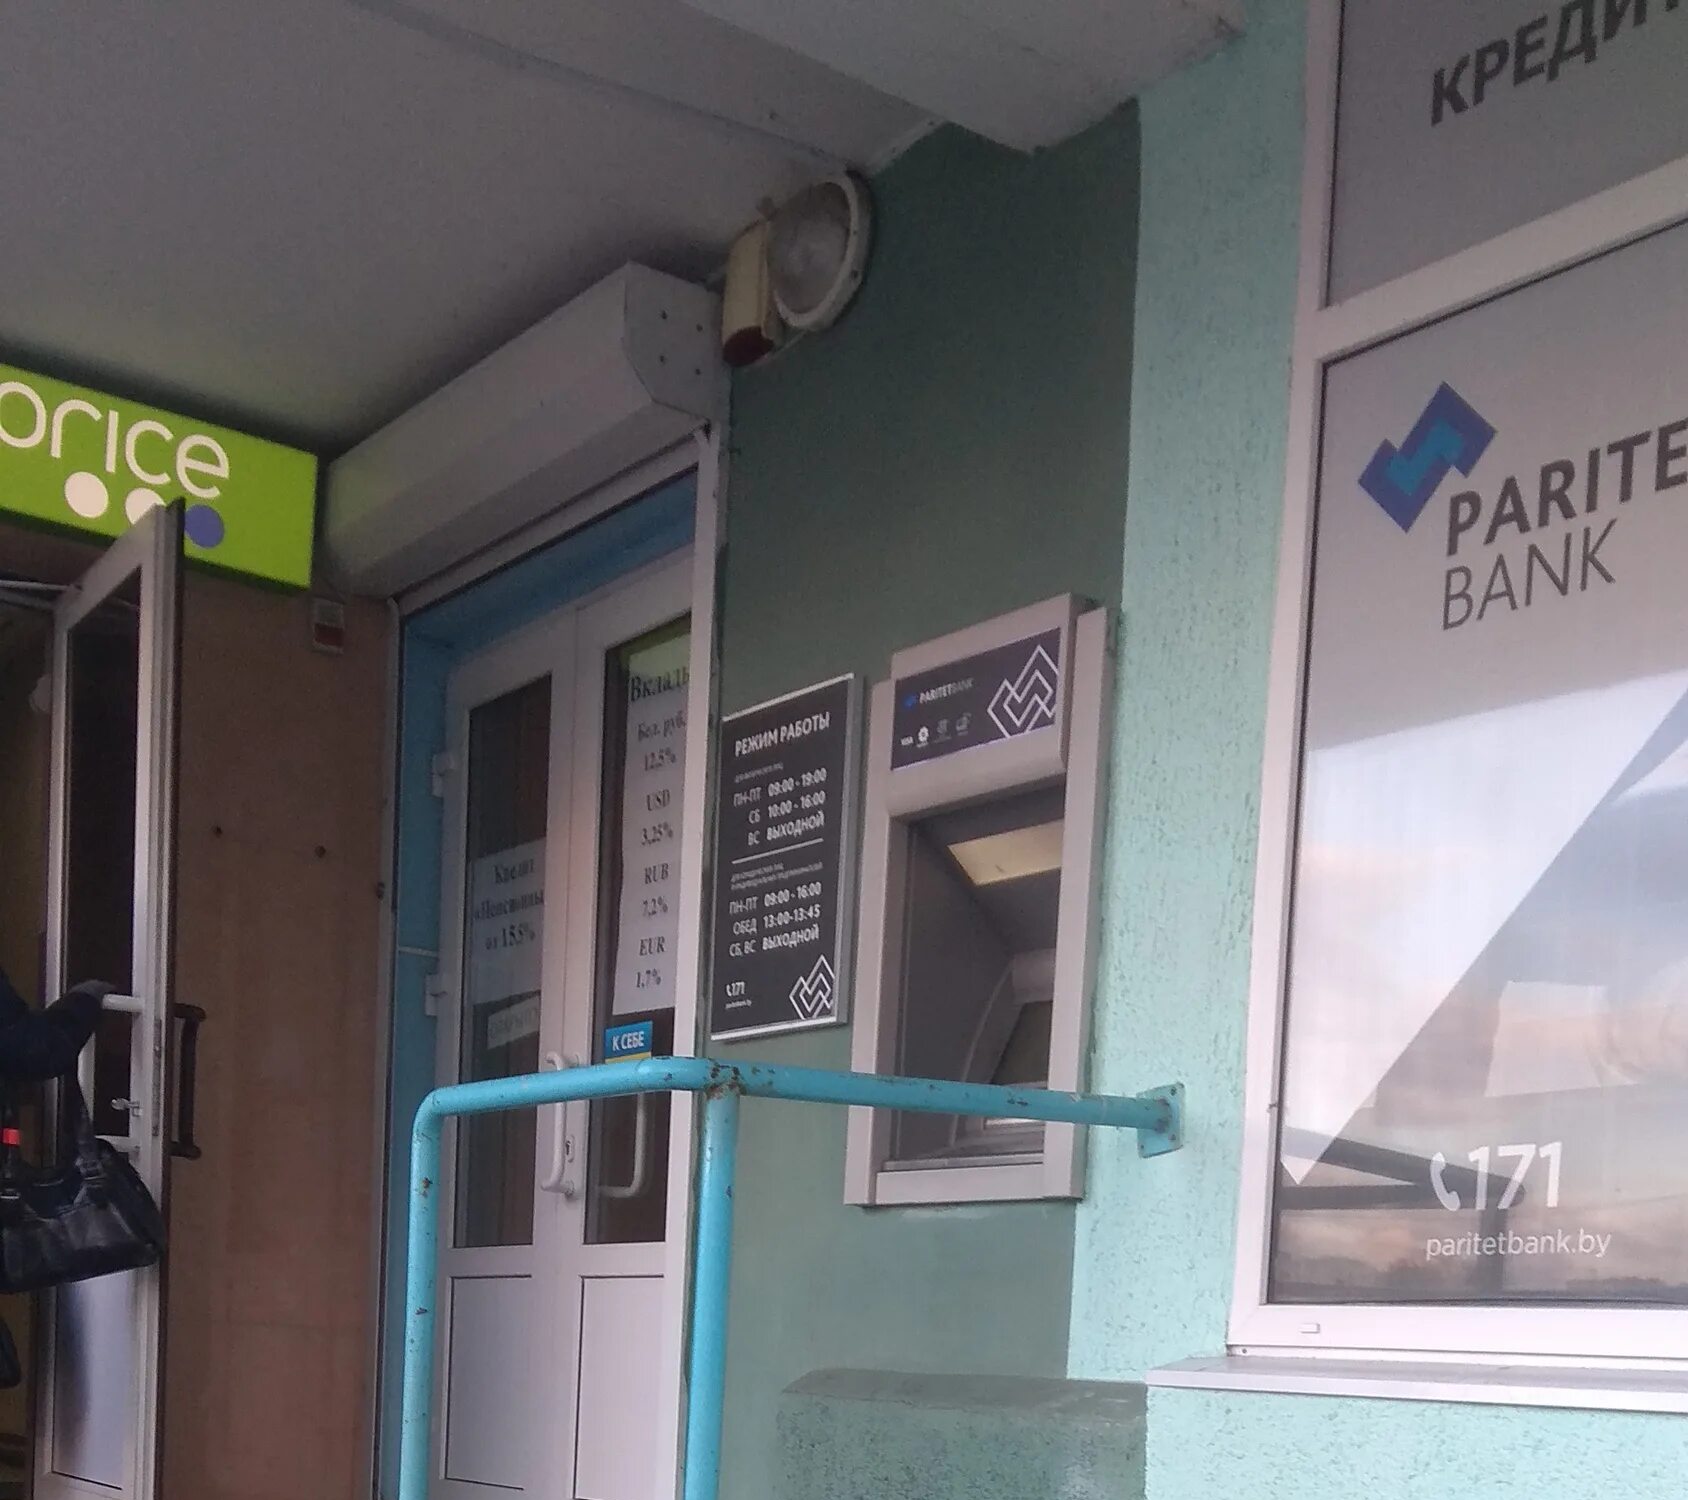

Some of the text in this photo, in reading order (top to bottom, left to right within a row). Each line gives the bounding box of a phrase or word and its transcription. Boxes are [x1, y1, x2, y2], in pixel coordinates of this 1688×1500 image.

[1429, 0, 1679, 126] КРЕДИ
[1443, 517, 1617, 630] BANK
[735, 712, 830, 757] РЕЖИМ РАБОТЫ
[646, 789, 671, 812] USD
[733, 787, 761, 807] ПН-ПТ
[749, 809, 760, 824] СБ
[768, 800, 793, 818] 10:00
[800, 790, 826, 809] 16:00
[748, 810, 825, 846] ВС ВЫХОДНОЙ
[644, 862, 669, 885] RUB
[729, 896, 758, 915] ПН-ПТ
[796, 881, 822, 899] 16:00
[733, 918, 757, 936] ОБЕД
[744, 939, 756, 955] ВС
[762, 923, 820, 950] ВЫХОДНОЙ
[639, 936, 666, 957] EUR
[612, 1031, 644, 1051] К СЕБЕ
[1468, 1141, 1562, 1211] 171
[1425, 1227, 1612, 1261] paritetbank.by
